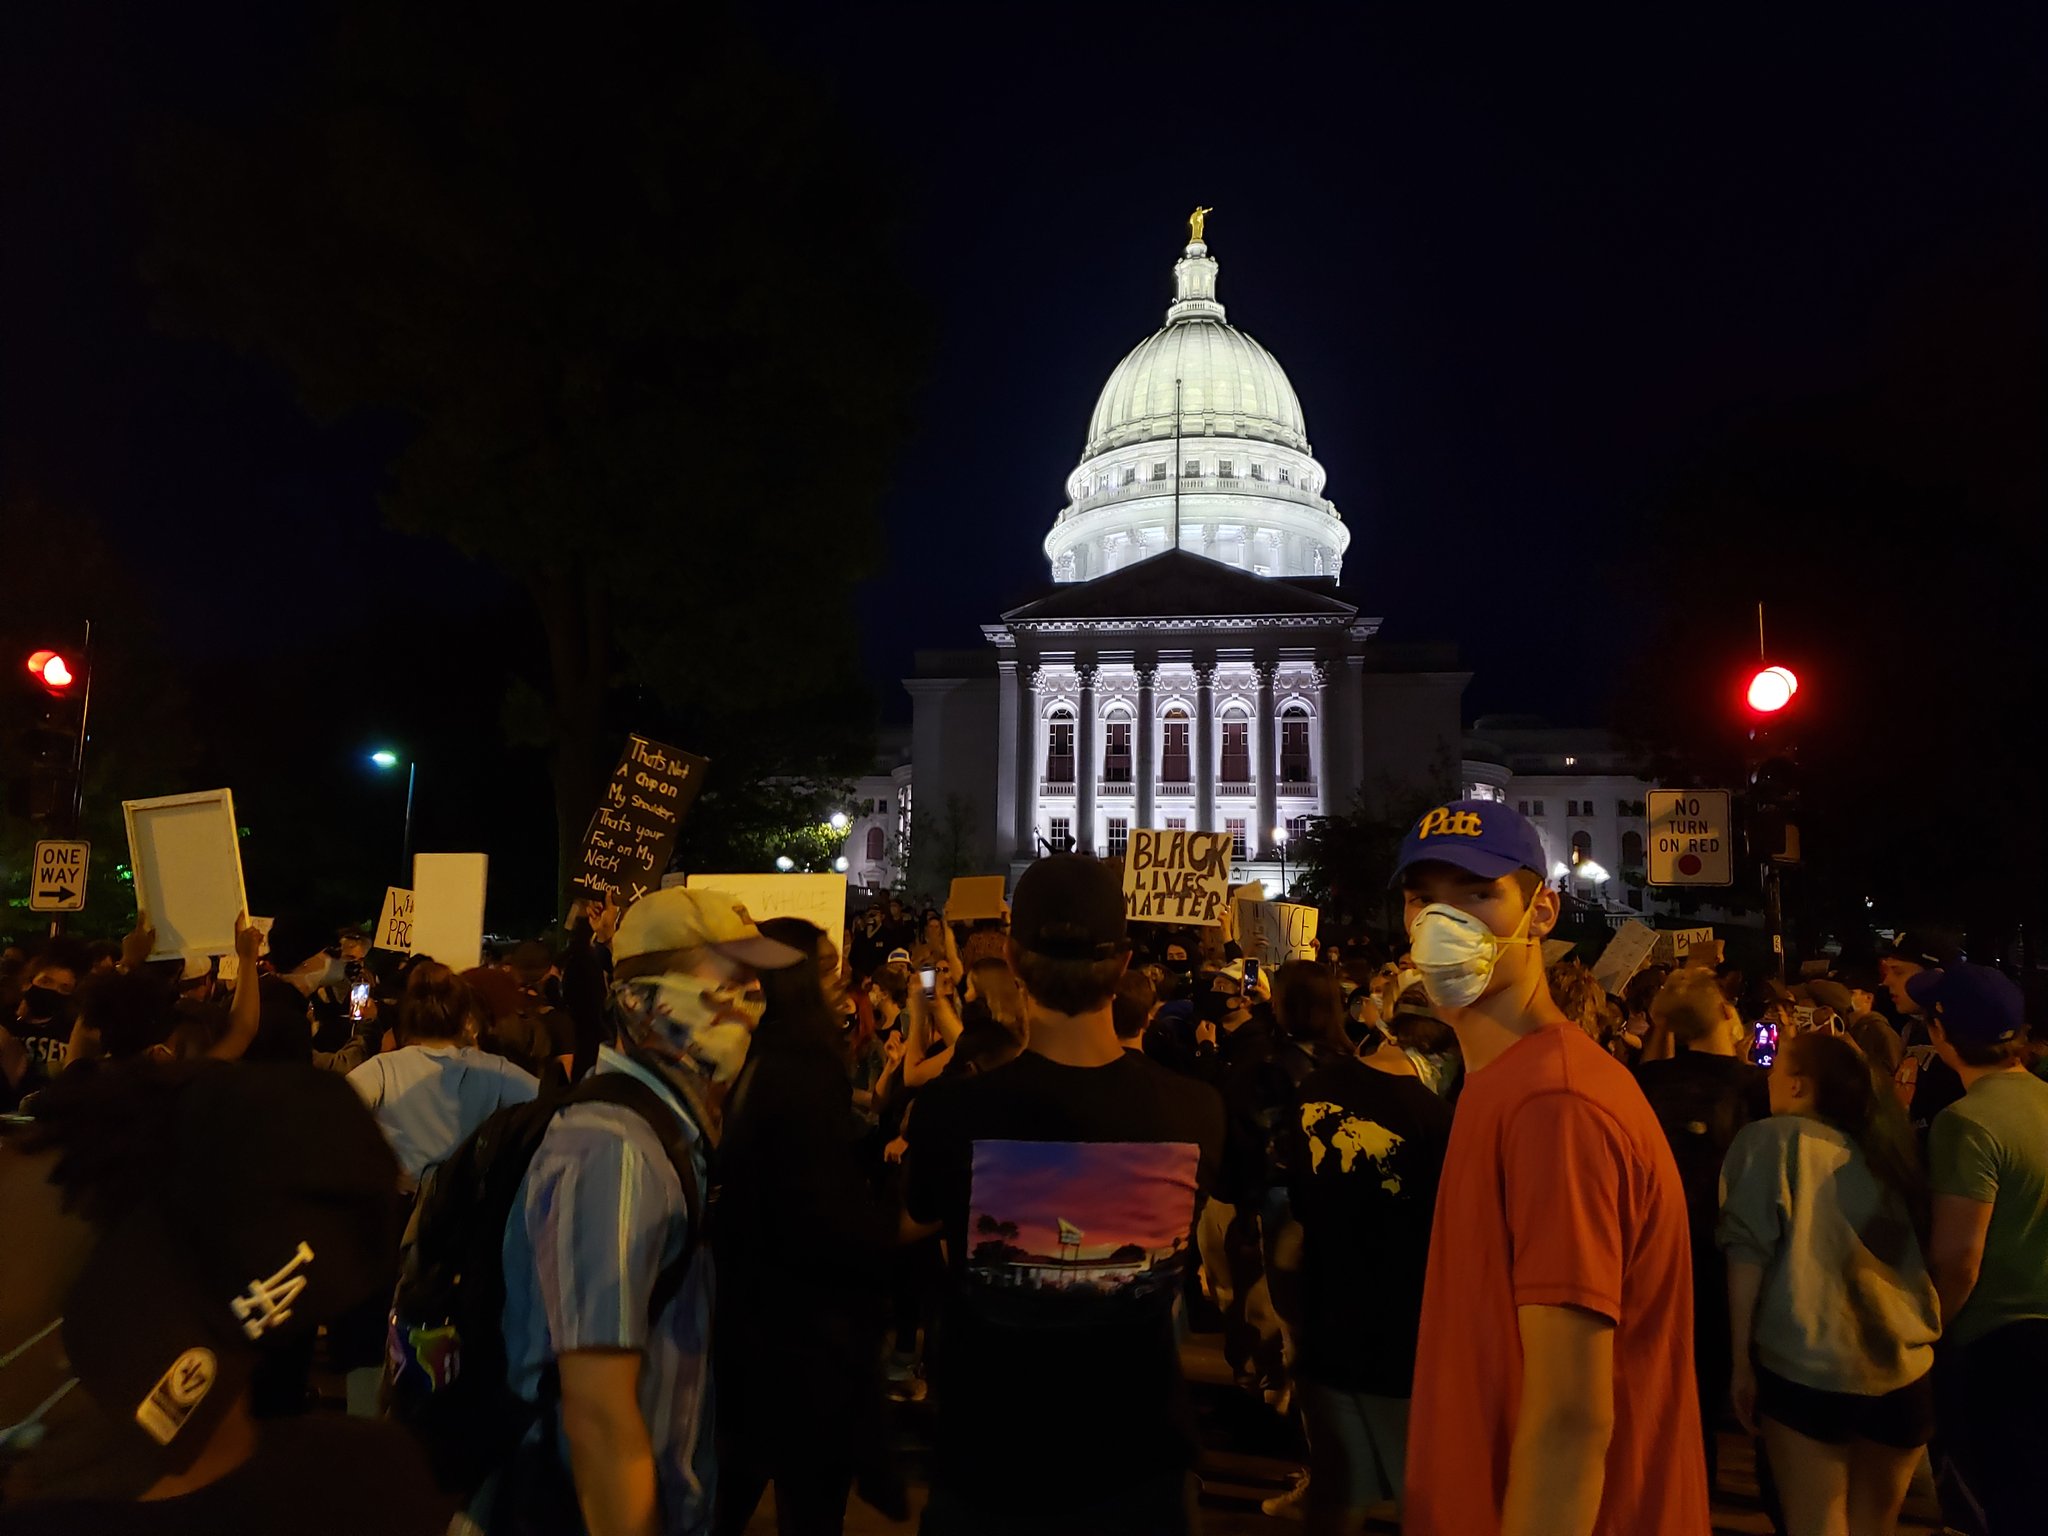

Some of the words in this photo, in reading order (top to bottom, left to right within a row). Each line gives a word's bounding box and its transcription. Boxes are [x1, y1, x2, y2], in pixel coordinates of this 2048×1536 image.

[667, 760, 690, 779] Not
[616, 762, 629, 777] A
[635, 771, 658, 792] Chip
[659, 782, 679, 798] on
[608, 782, 626, 808] My
[1675, 798, 1700, 816] NO
[1418, 805, 1483, 840] Pitt
[1668, 820, 1709, 834] TURN
[635, 825, 665, 843] your
[590, 831, 615, 849] Foot
[617, 844, 633, 856] on
[636, 845, 655, 871] My
[1659, 838, 1679, 852] ON
[1689, 838, 1719, 852] RED
[43, 849, 80, 865] ONE
[1133, 831, 1232, 880] BLACK
[41, 868, 79, 883] WAY
[1135, 871, 1209, 898] LIVES
[629, 882, 648, 902] X
[1124, 890, 1221, 921] MATTER
